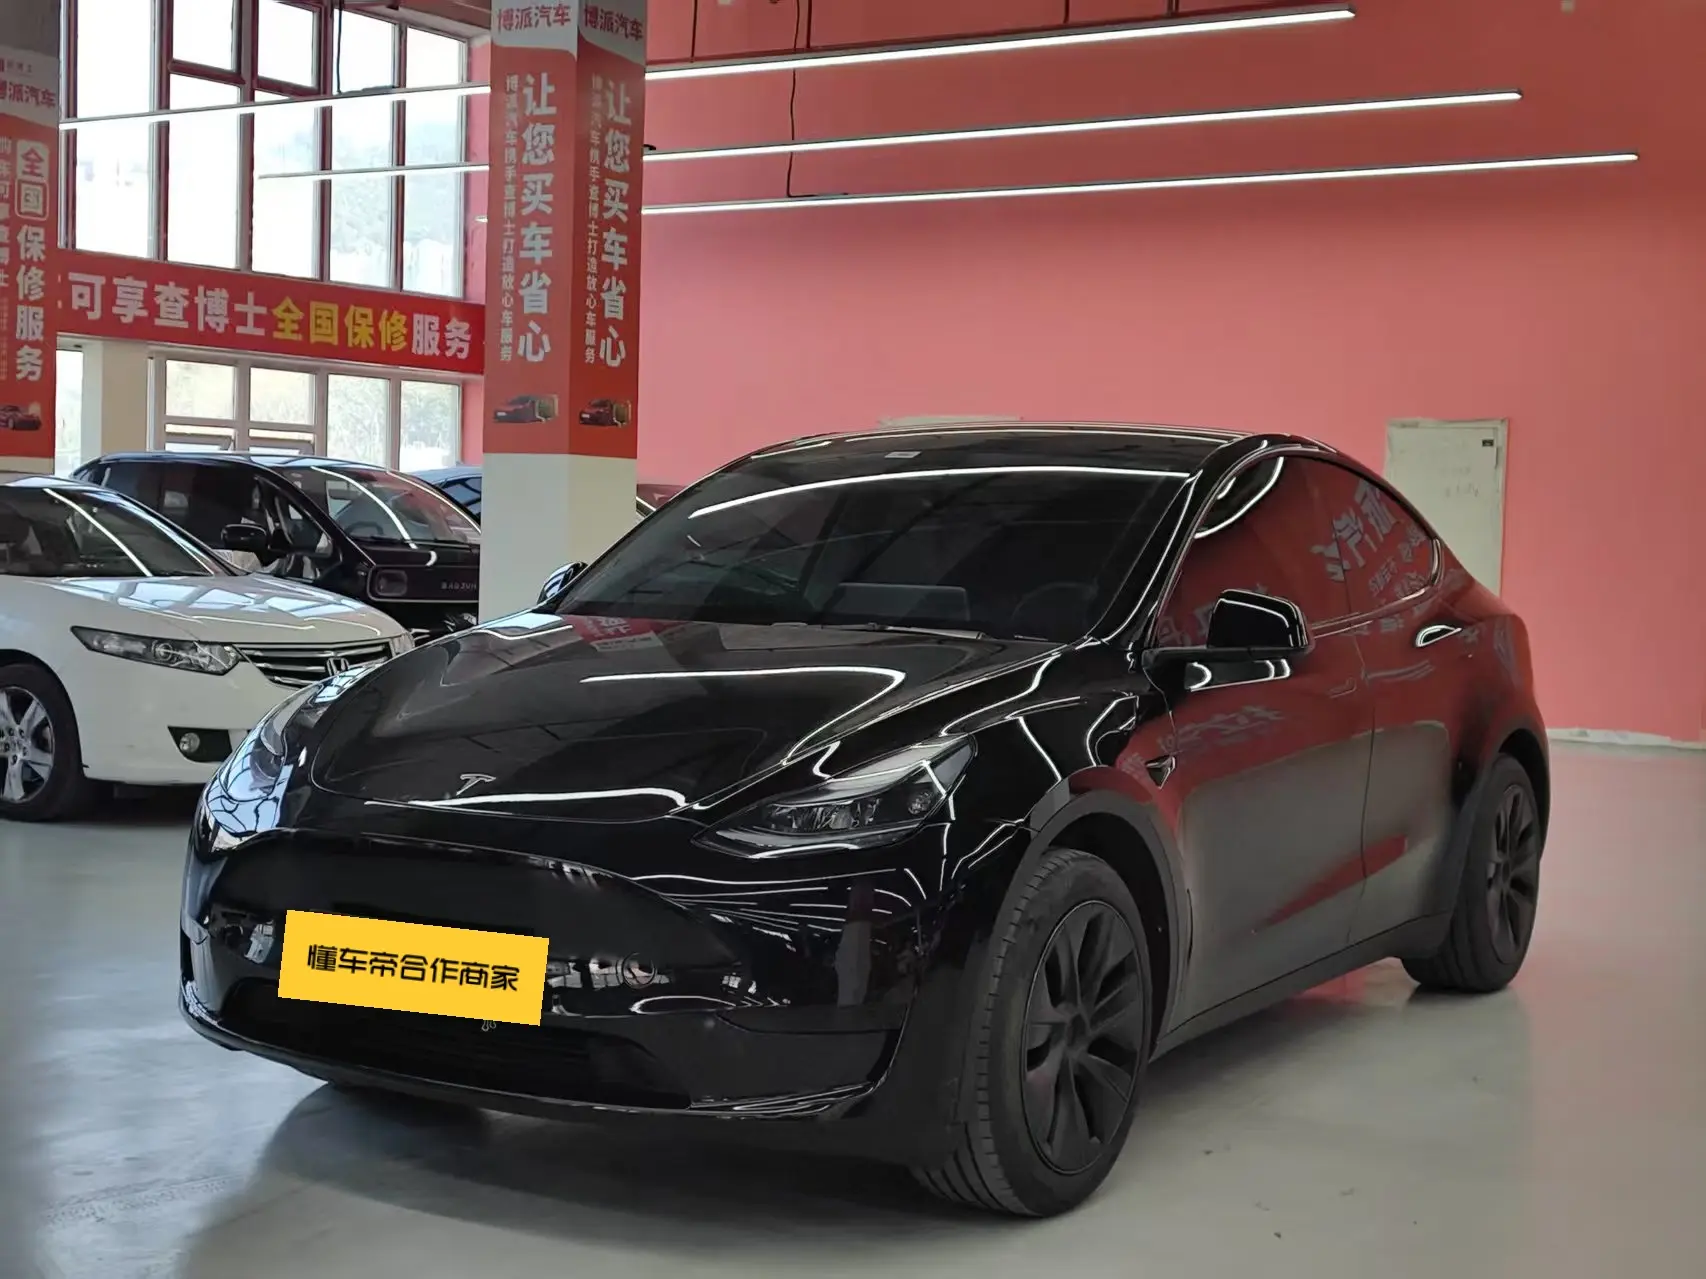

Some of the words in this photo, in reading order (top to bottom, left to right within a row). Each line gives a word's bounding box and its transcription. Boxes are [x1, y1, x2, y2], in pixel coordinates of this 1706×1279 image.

[498, 4, 571, 33] 博派汽车
[585, 5, 643, 41] 博派汽车
[16, 145, 46, 381] 全国保修服务
[517, 72, 557, 362] 让您买车省心
[599, 79, 632, 367] 让您买车省心
[58, 272, 472, 359] 可享查博士全国保修服务
